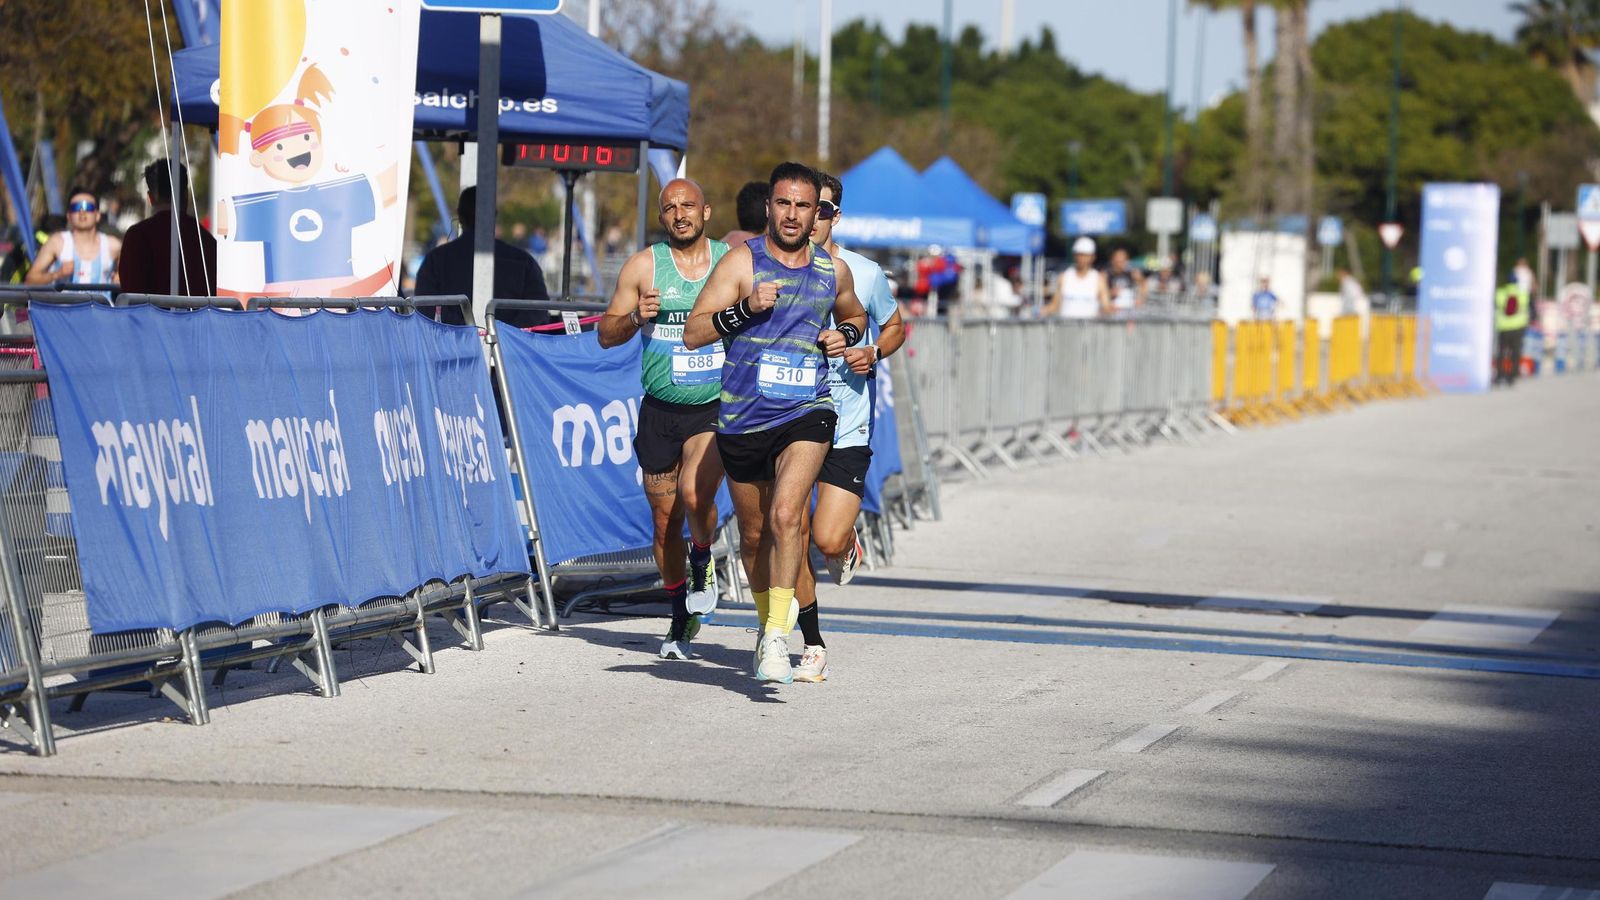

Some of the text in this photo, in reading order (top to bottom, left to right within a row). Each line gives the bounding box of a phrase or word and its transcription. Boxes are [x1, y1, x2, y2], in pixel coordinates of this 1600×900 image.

[687, 354, 714, 369] 688
[775, 366, 804, 383] 510
[92, 396, 213, 541] mayoral
[246, 389, 351, 523] mayoral
